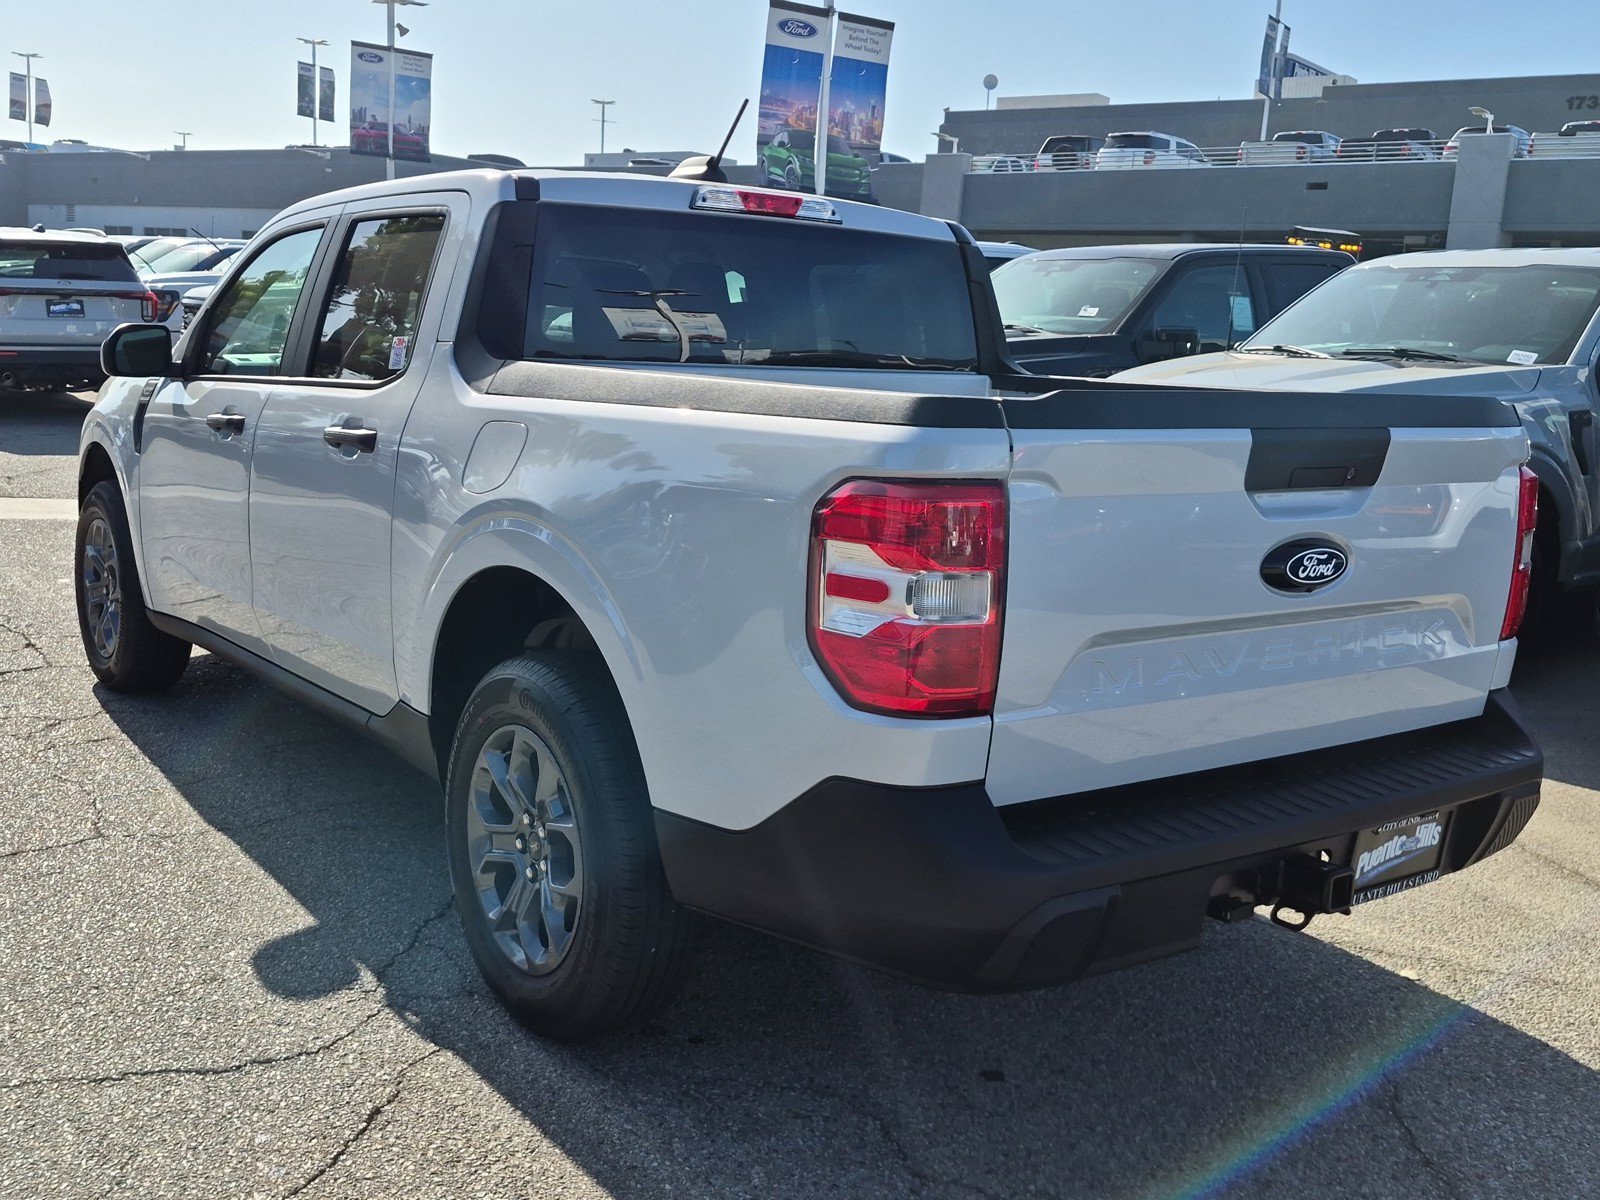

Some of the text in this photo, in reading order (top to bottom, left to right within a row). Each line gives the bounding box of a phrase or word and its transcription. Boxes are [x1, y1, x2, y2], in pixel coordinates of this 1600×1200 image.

[784, 20, 810, 36] Ford
[843, 24, 888, 38] Imagine Yourself
[845, 43, 863, 51] Wheel
[849, 34, 868, 43] Behind
[1298, 553, 1337, 578] Ford
[1090, 619, 1444, 692] MAVERICK
[1355, 835, 1406, 880] Puente
[1416, 822, 1441, 848] Hills
[1352, 870, 1440, 906] UENTE HILLS FORD
